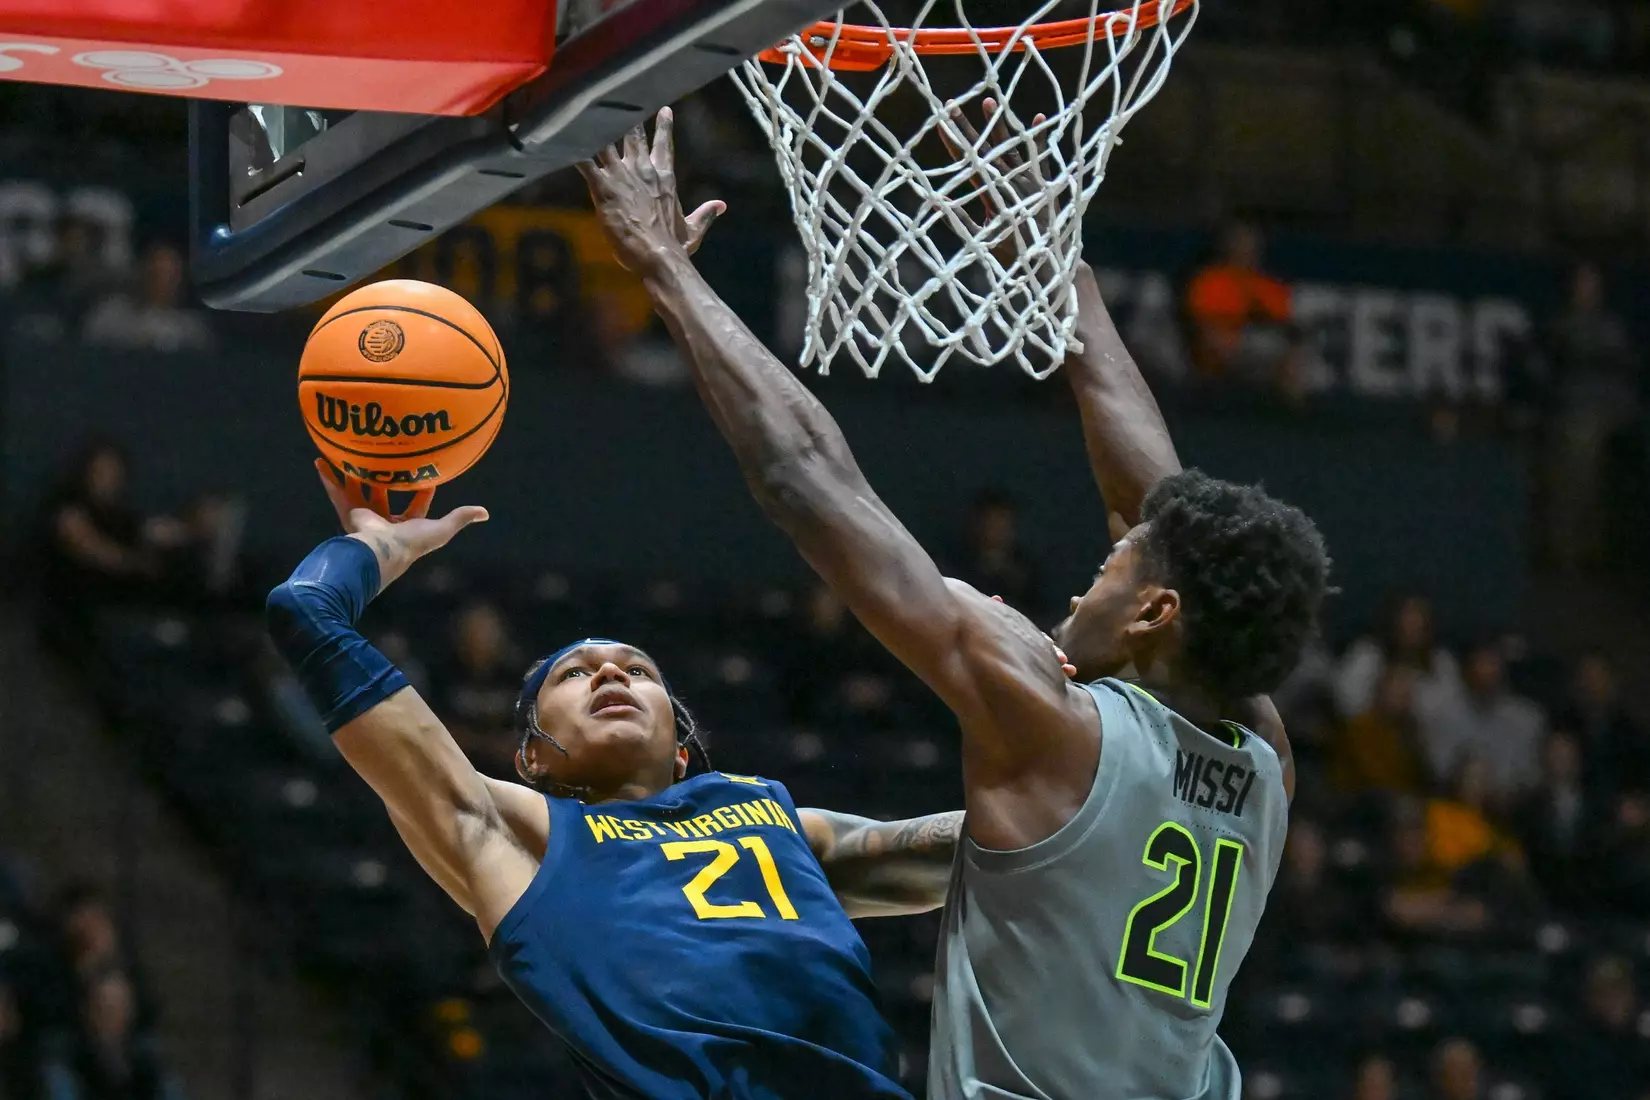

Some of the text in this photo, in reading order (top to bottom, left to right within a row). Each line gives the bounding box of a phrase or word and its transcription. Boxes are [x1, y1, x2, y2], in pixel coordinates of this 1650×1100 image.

[315, 391, 453, 438] Wilson
[341, 460, 441, 484] NCAA
[1172, 749, 1257, 817] MISSI
[585, 798, 798, 844] WEST VIRGINIA
[660, 835, 800, 920] 21
[1115, 820, 1244, 1009] 21
